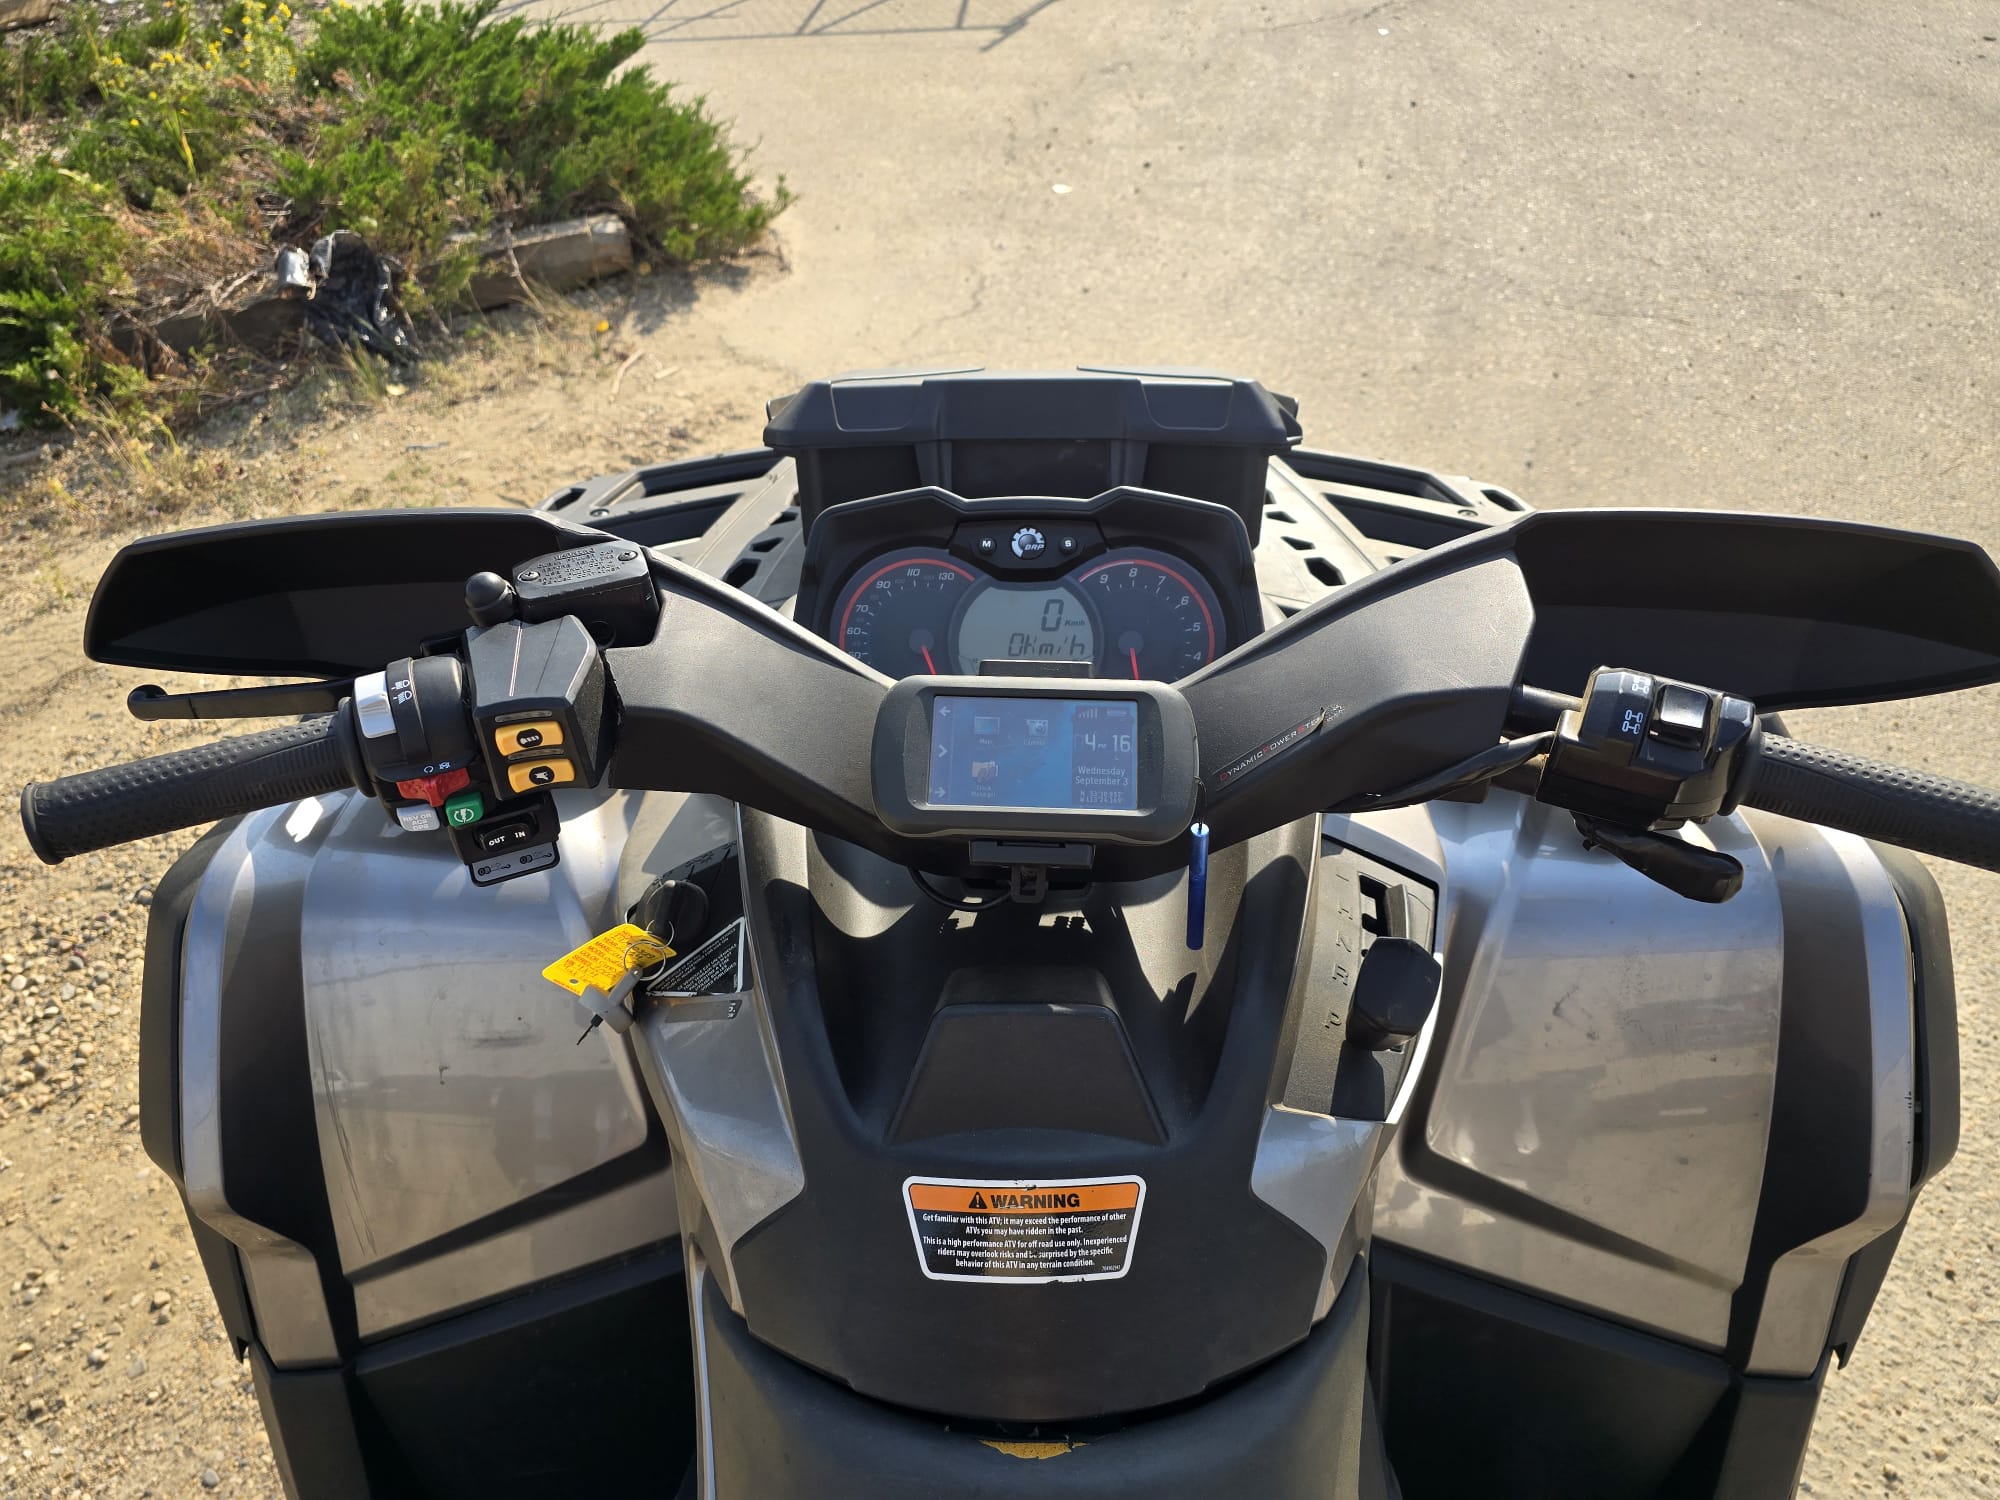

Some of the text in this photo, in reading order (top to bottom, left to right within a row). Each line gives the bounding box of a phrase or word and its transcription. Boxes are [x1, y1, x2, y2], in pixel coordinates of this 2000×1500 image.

[1129, 568, 1137, 577] 8
[1100, 574, 1108, 583] 9
[1159, 576, 1166, 585] 7
[1181, 596, 1189, 605] 6
[1041, 599, 1064, 631] 0
[1193, 622, 1200, 631] 5
[1193, 652, 1201, 660] 4
[1085, 734, 1096, 751] 4
[1112, 735, 1130, 752] 16
[1078, 766, 1125, 777] Wednesday
[1076, 776, 1128, 786] September 3
[489, 836, 505, 845] OUT
[990, 1193, 1080, 1209] WARNING
[935, 1214, 959, 1223] familiar
[960, 1216, 974, 1224] with
[1010, 1218, 1023, 1226] may
[1025, 1217, 1046, 1225] exceed
[1060, 1214, 1100, 1225] performance
[1110, 1212, 1126, 1220] other
[981, 1228, 992, 1236] you
[1026, 1227, 1046, 1235] ridden
[1068, 1226, 1083, 1235] past.
[923, 1236, 935, 1244] This
[936, 1237, 941, 1245] is
[948, 1238, 961, 1247] high
[963, 1239, 1003, 1248] performance
[1005, 1240, 1016, 1248] ATV
[1017, 1240, 1026, 1248] for
[1039, 1240, 1053, 1248] road
[1084, 1235, 1127, 1246] Inexperienced
[938, 1248, 955, 1256] riders
[957, 1250, 970, 1258] may
[971, 1250, 998, 1258] overlook
[1000, 1250, 1014, 1258] risks
[1070, 1249, 1077, 1258] by
[1078, 1248, 1089, 1256] the
[1090, 1246, 1113, 1256] specific
[956, 1259, 983, 1267] behavior
[1027, 1262, 1038, 1270] any
[1063, 1259, 1095, 1267] condition.
